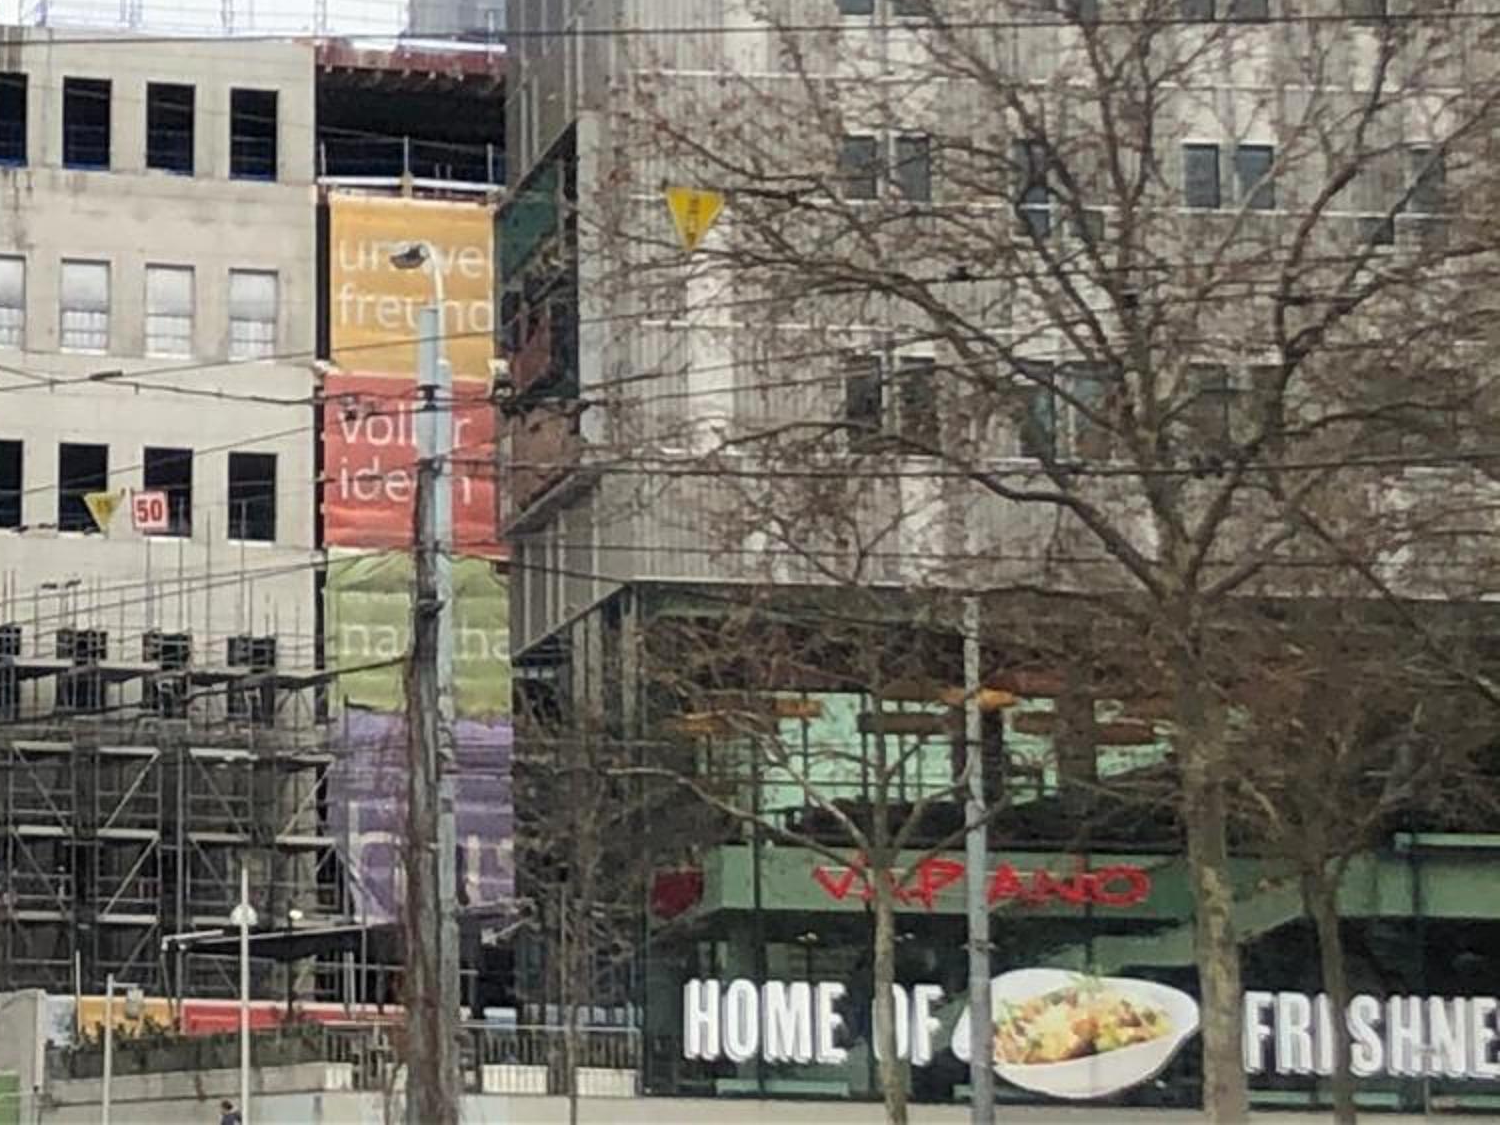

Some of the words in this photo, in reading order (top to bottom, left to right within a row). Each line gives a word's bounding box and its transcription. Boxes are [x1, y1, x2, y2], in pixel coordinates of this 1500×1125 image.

[337, 400, 472, 449] vollr
[339, 455, 472, 506] iden
[136, 498, 163, 523] 50
[813, 855, 1152, 909] VPANO
[683, 977, 848, 1065] HOME
